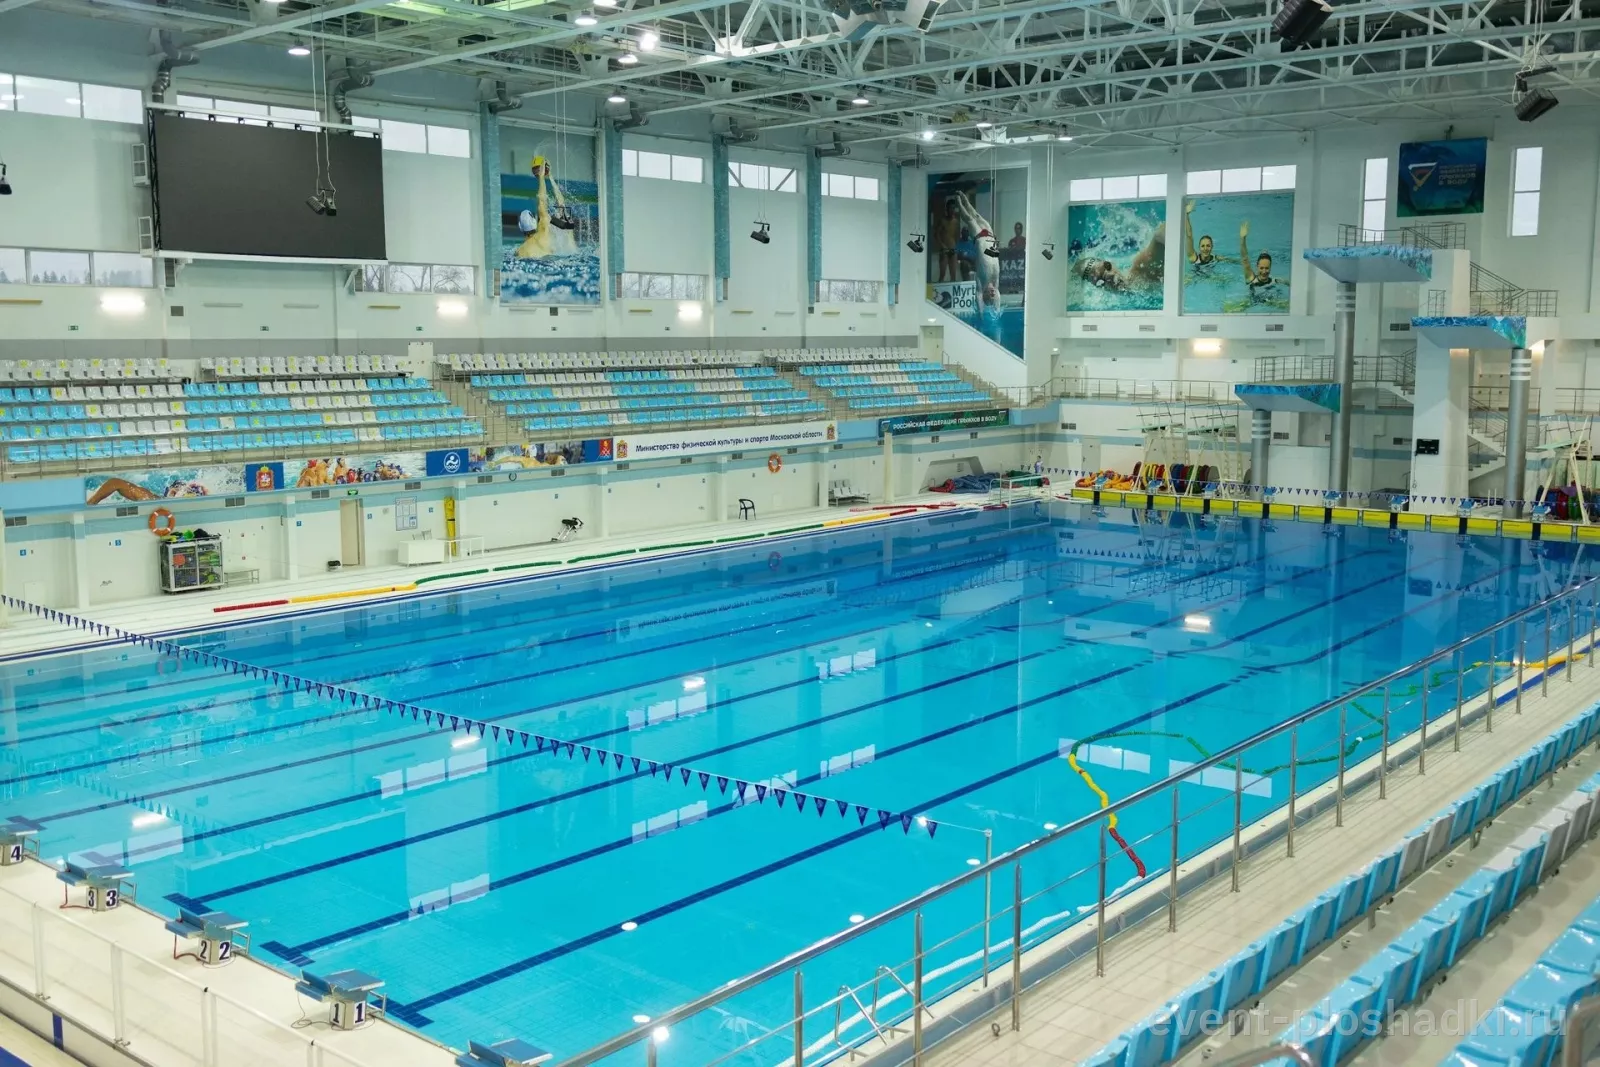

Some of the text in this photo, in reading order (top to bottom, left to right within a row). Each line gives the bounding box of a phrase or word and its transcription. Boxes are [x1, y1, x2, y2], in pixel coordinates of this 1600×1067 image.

[893, 421, 926, 429] РОССИЙСКАЯ
[926, 418, 957, 426] ФЕДЕРАЦИЯ
[636, 443, 680, 453] Министерство
[681, 438, 717, 450] физической
[717, 437, 744, 447] культуры
[750, 436, 769, 445] спорта
[770, 431, 802, 442] Московской
[802, 430, 823, 438] области
[11, 845, 21, 860] 4
[88, 890, 95, 907] 3
[106, 889, 117, 907] 3
[200, 940, 207, 960] 2
[219, 941, 230, 960] 2
[333, 1003, 340, 1024] 1
[354, 1002, 364, 1023] 1
